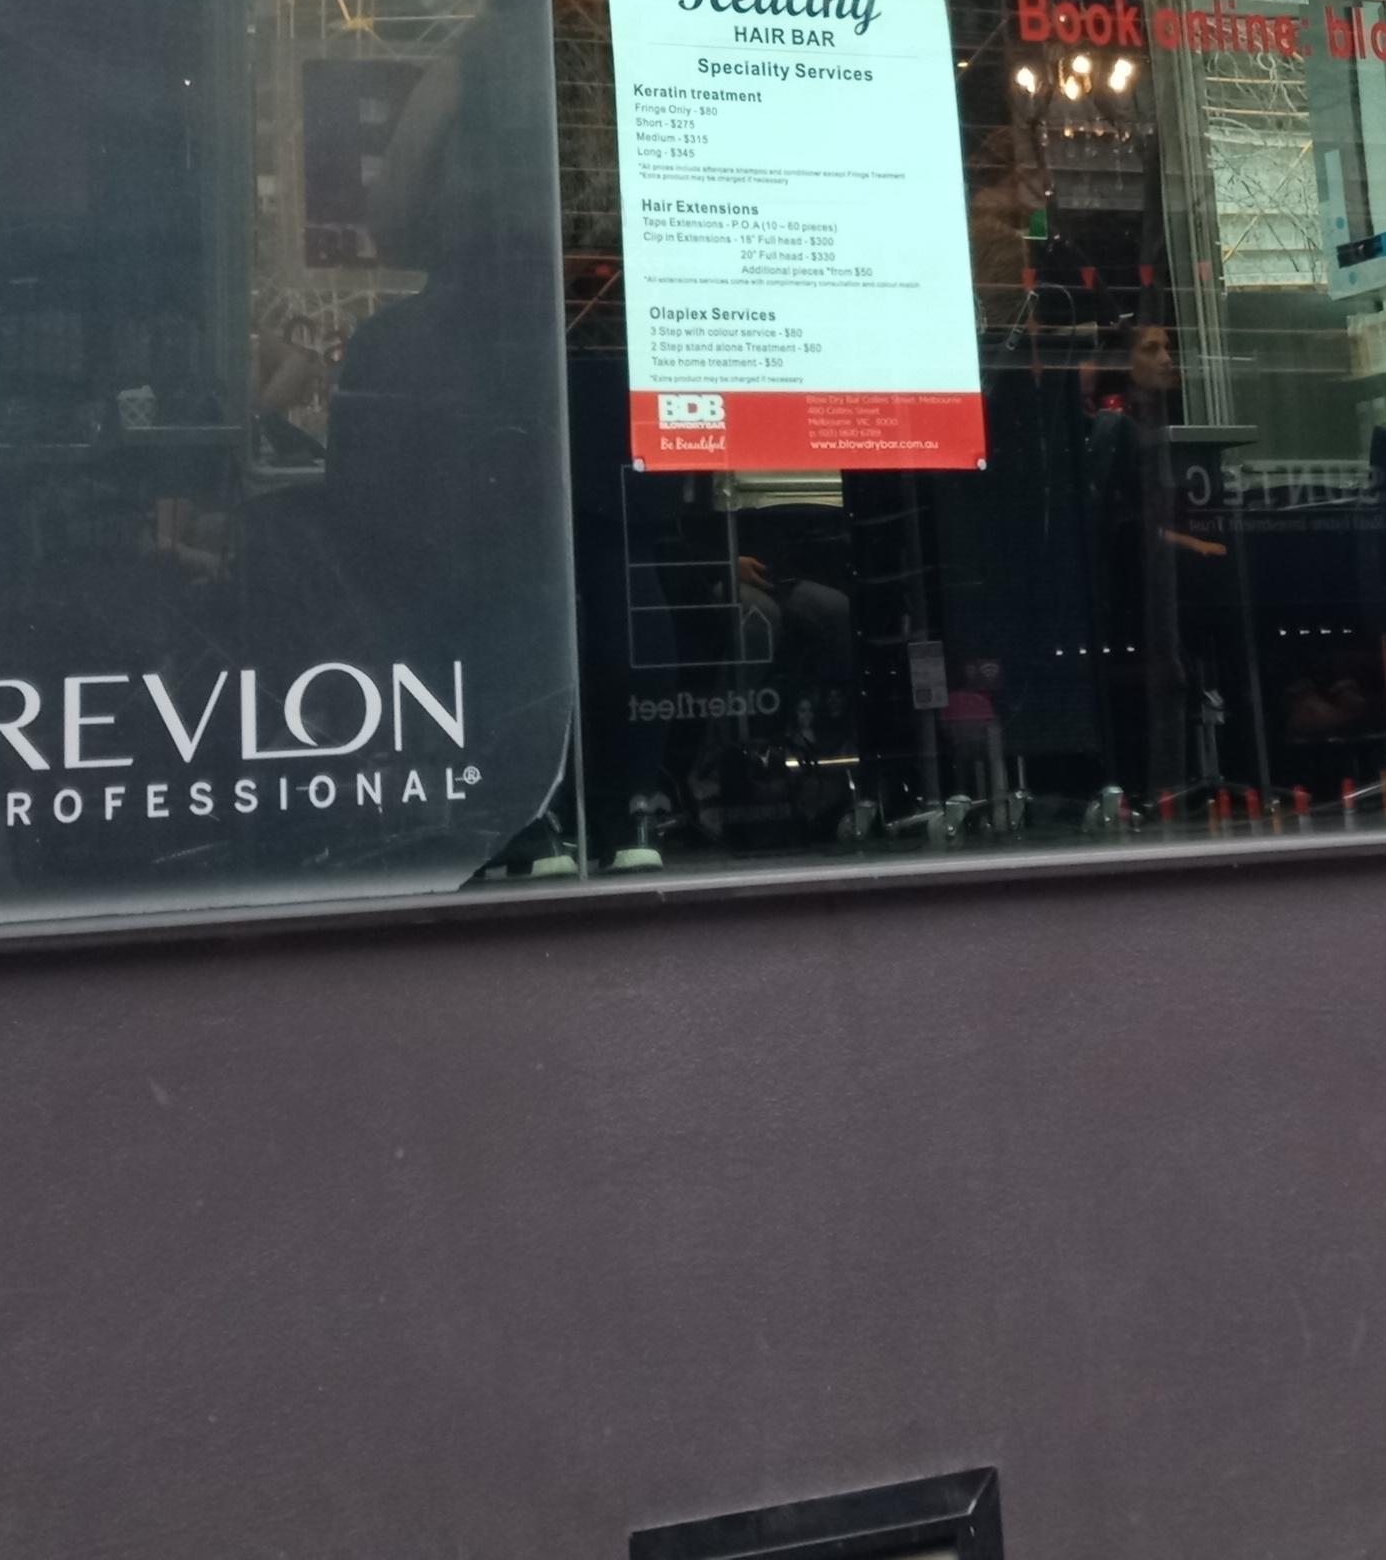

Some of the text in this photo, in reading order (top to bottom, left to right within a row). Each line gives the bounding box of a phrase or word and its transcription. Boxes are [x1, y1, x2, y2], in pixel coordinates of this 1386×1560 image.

[734, 26, 836, 48] HAIR BAR
[698, 58, 873, 82] Speciality Services
[633, 84, 762, 103] Keratin treatment
[634, 102, 718, 116] Fringe Only $80
[636, 117, 695, 129] Short $275
[636, 132, 708, 144] Medium $315
[637, 147, 695, 158] Long $345
[642, 198, 759, 215] Hair Extensions
[643, 217, 667, 228] Tape
[669, 218, 724, 228] Extensions
[802, 223, 837, 233] pieces)
[643, 232, 663, 242] Clip
[665, 232, 675, 242] in
[676, 232, 731, 243] Extensions
[758, 235, 775, 245] Full
[778, 236, 802, 245] head
[810, 236, 834, 246] $300
[759, 250, 776, 260] Full
[779, 251, 803, 261] head
[811, 251, 835, 261] $330
[742, 266, 790, 275] Additional
[793, 267, 824, 277] pieces
[855, 267, 872, 277] $50
[649, 306, 776, 322] Olaplex Services
[650, 327, 656, 336] 3
[659, 327, 682, 338] Step
[685, 327, 705, 336] with
[708, 328, 738, 337] colour
[741, 328, 776, 337] service
[651, 342, 657, 351] 2
[659, 342, 683, 352] Step
[686, 342, 713, 352] stand
[716, 343, 743, 352] alone
[745, 342, 796, 352] Treatment
[651, 357, 783, 368] Take home treatment $50
[658, 394, 726, 422] BDB
[660, 434, 726, 453] Be Beautiful
[810, 440, 939, 451] www.blowdrybar.com.au
